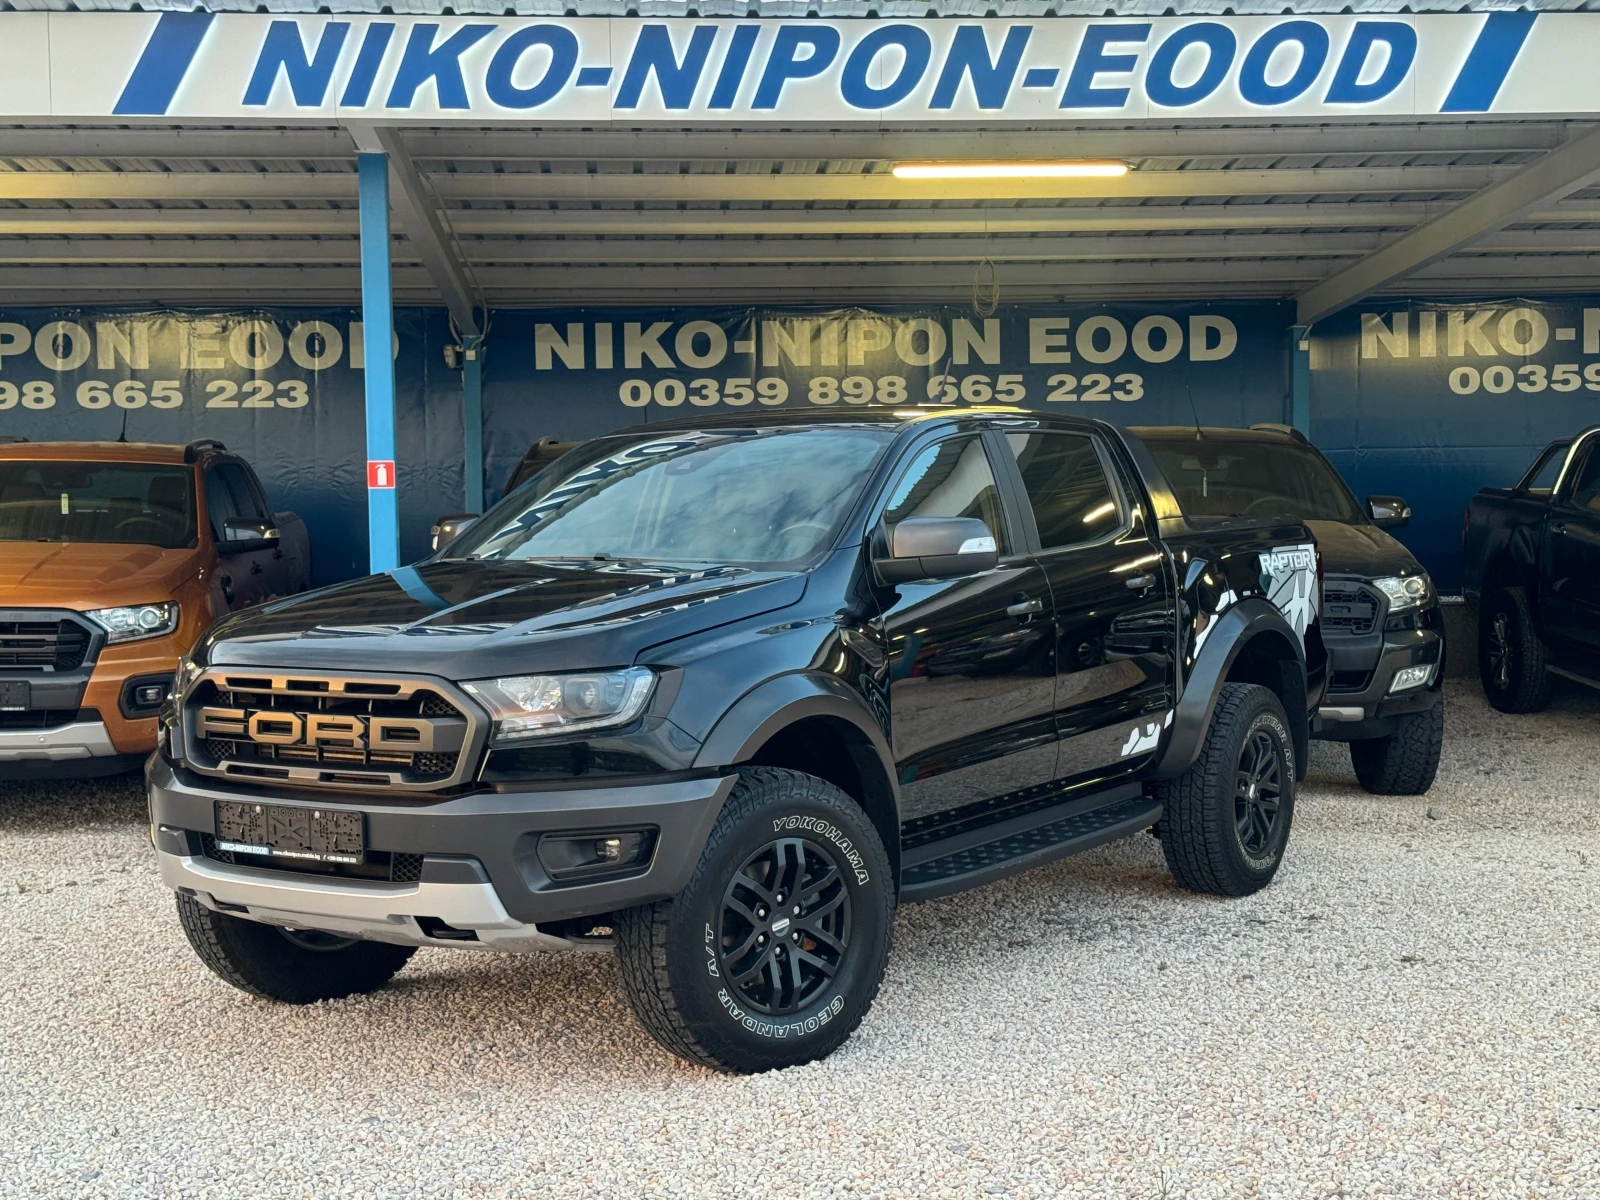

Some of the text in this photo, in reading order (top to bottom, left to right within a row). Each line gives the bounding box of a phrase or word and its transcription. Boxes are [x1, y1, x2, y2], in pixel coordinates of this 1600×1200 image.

[241, 20, 1418, 110] NIKO-NIPON-EOOD
[534, 315, 1238, 370] NIKO-NIPON EOOD
[76, 380, 183, 409] 665
[205, 380, 309, 408] 223
[619, 373, 1144, 407] 00359 898 665 223
[1259, 551, 1314, 582] RAPTOR
[197, 706, 434, 751] FORD
[773, 815, 869, 885] YOKOHAMA
[705, 923, 844, 1038] GEOLANDAR A/T
